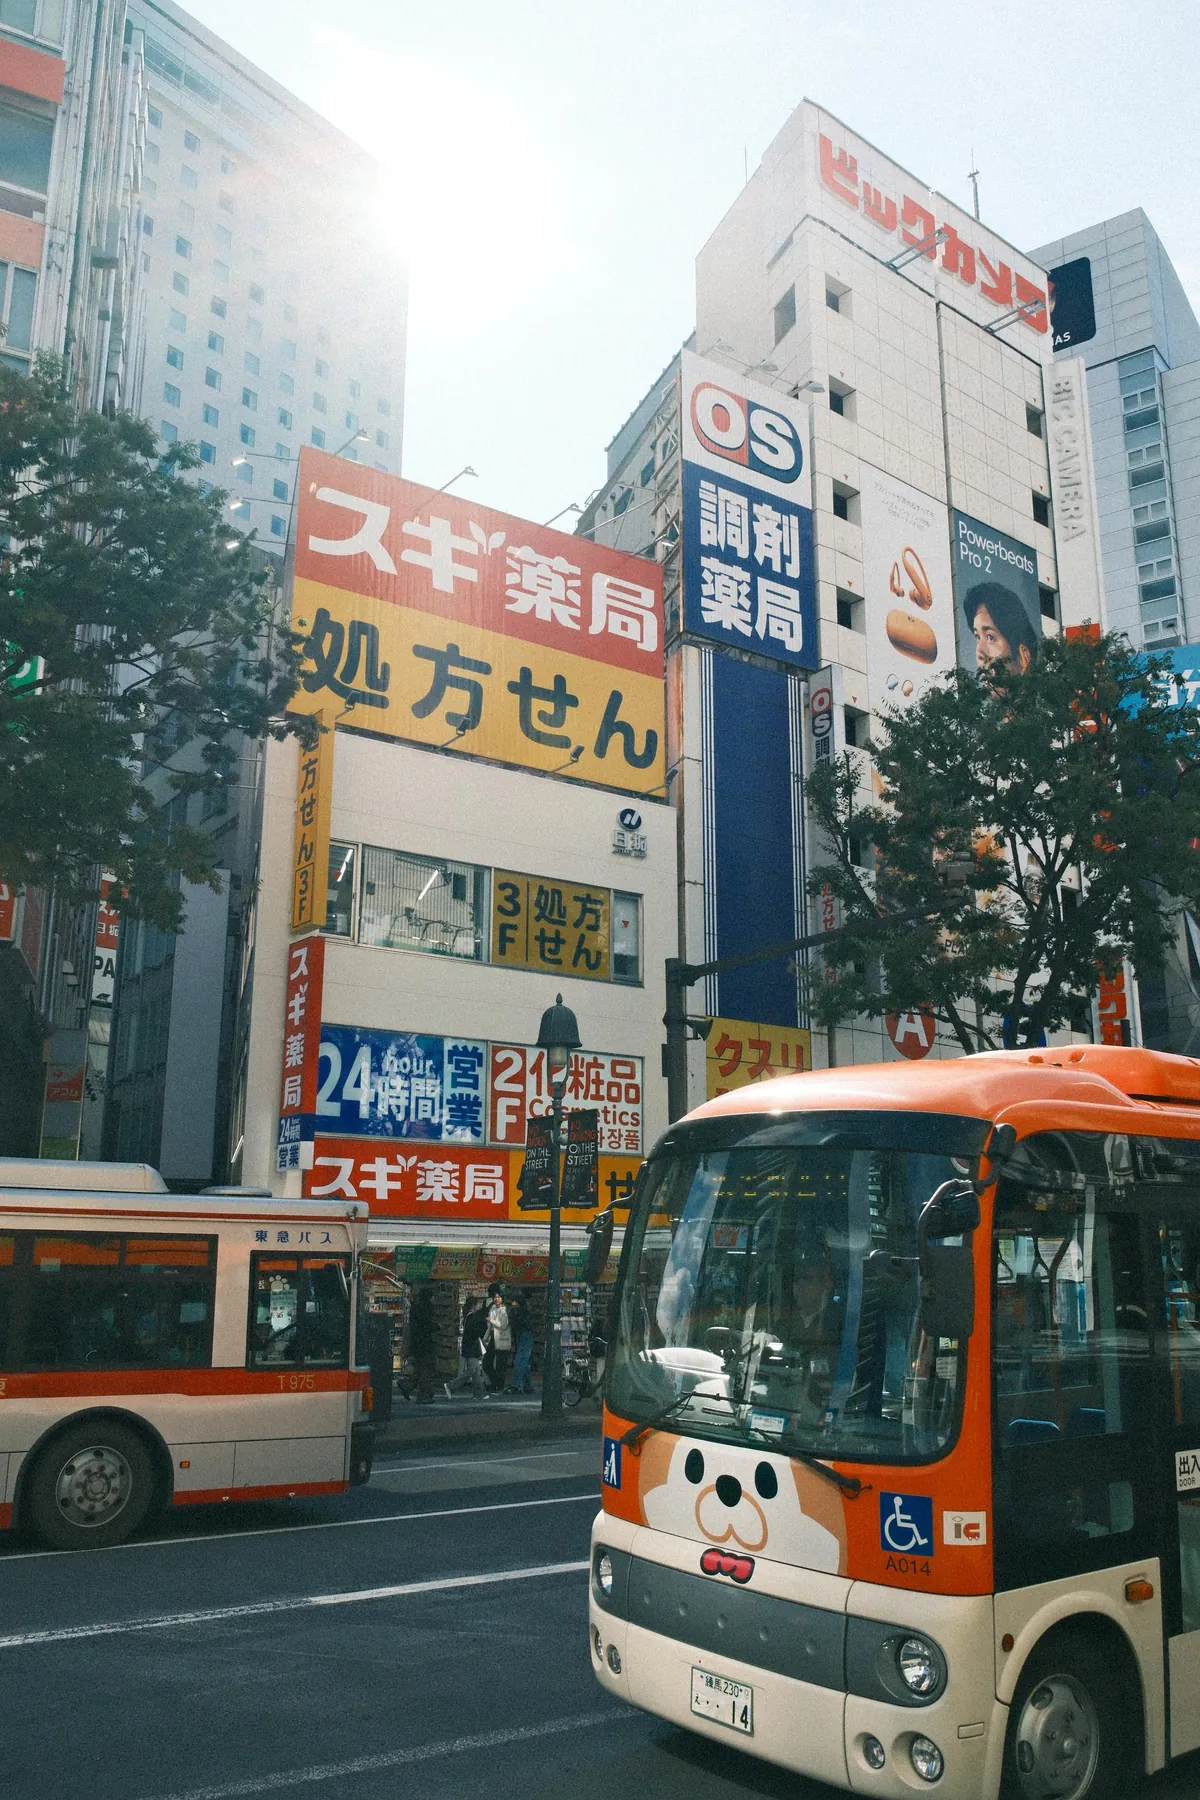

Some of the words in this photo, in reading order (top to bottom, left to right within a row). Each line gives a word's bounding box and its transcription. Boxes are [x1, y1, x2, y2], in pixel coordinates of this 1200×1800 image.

[818, 132, 1048, 334] ビックカメラ
[1052, 331, 1071, 346] AS
[1052, 375, 1075, 422] BIC
[696, 386, 796, 471] OS
[1056, 427, 1086, 543] CAMERA
[699, 480, 800, 579] 調剤
[958, 520, 1035, 575] Powerbeats
[308, 486, 658, 652] スギ薬局
[960, 541, 982, 569] Pro
[984, 555, 993, 574] 2
[700, 556, 803, 653] 薬局
[303, 607, 659, 769] 処方せん
[813, 691, 830, 735] OS
[283, 947, 309, 1110] スギ薬局
[894, 1004, 929, 1048] A
[384, 1054, 434, 1075] hour
[529, 1050, 641, 1105] 化粧品
[714, 1031, 804, 1080] クスリ
[311, 1154, 504, 1203] スギ薬局
[525, 1158, 549, 1170] STREET
[255, 1230, 332, 1244] 東急バス
[1179, 1477, 1196, 1487] DOOR
[886, 1556, 931, 1576] A014
